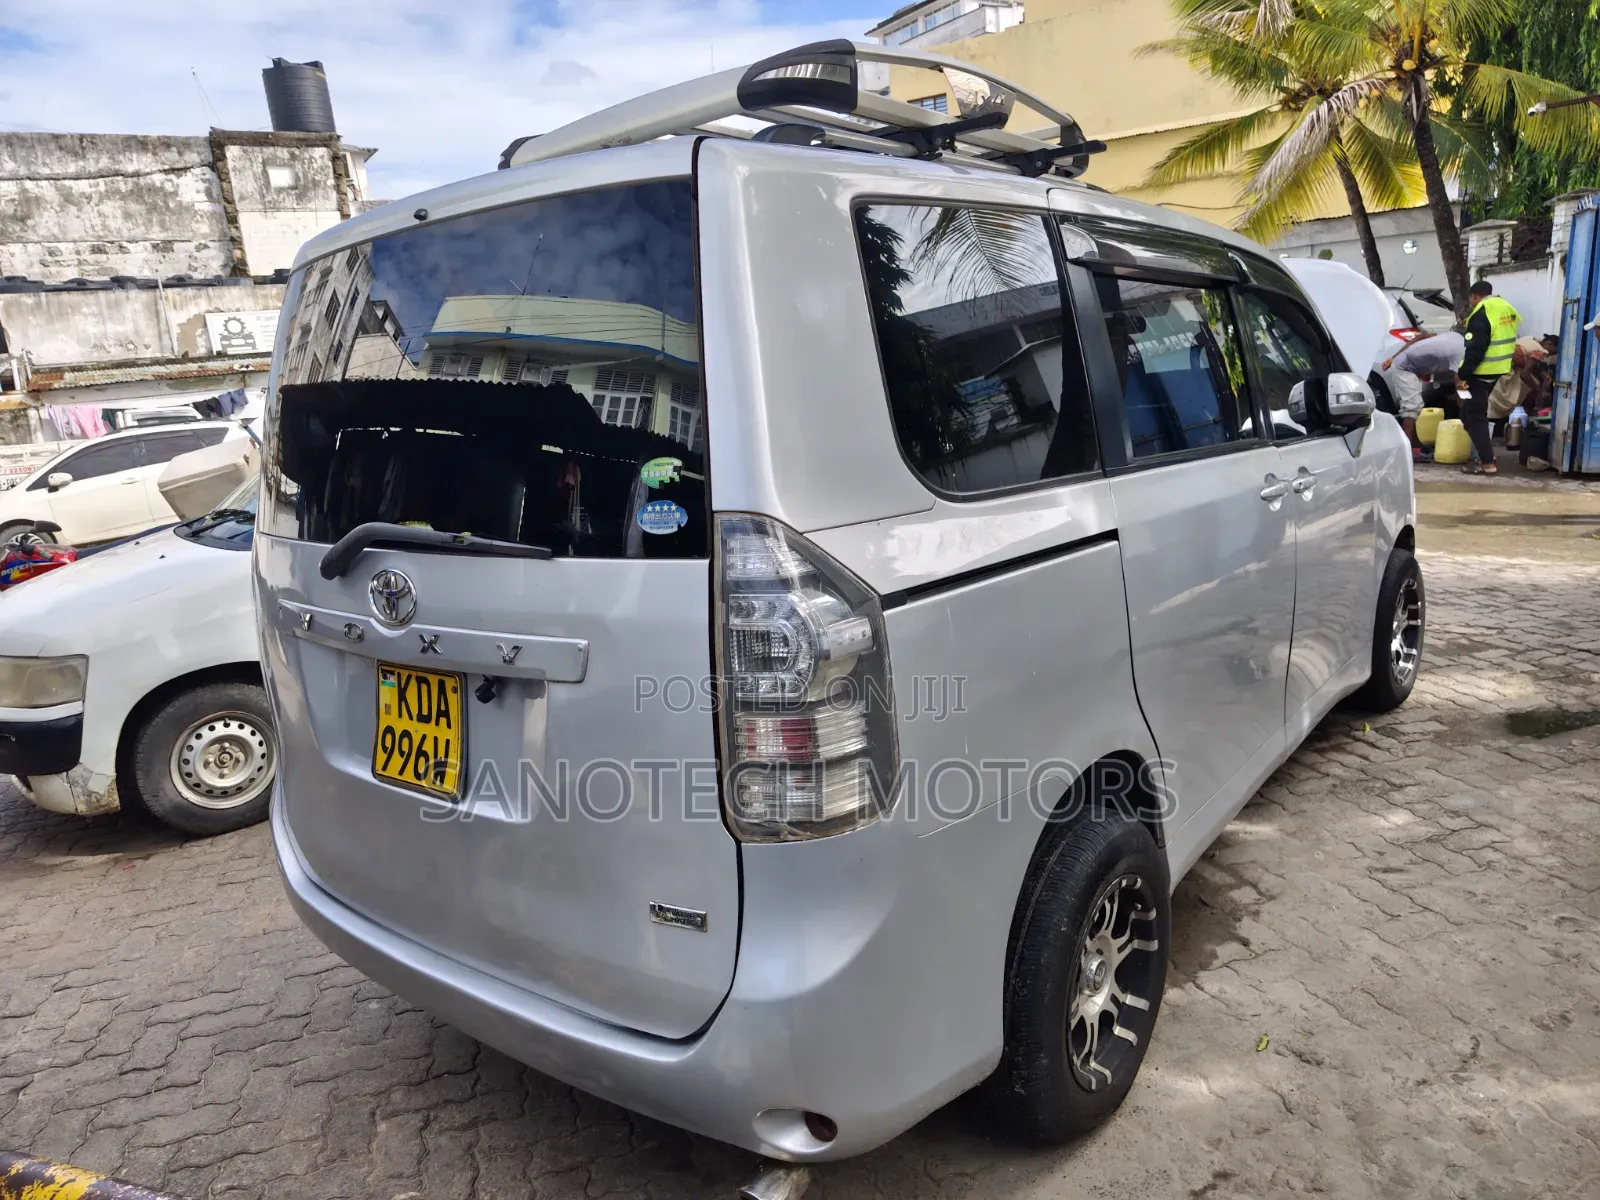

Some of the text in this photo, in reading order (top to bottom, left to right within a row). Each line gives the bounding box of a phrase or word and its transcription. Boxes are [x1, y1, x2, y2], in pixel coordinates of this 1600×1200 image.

[300, 612, 523, 665] VOXY
[396, 671, 452, 730] KDA
[380, 724, 451, 787] 996W
